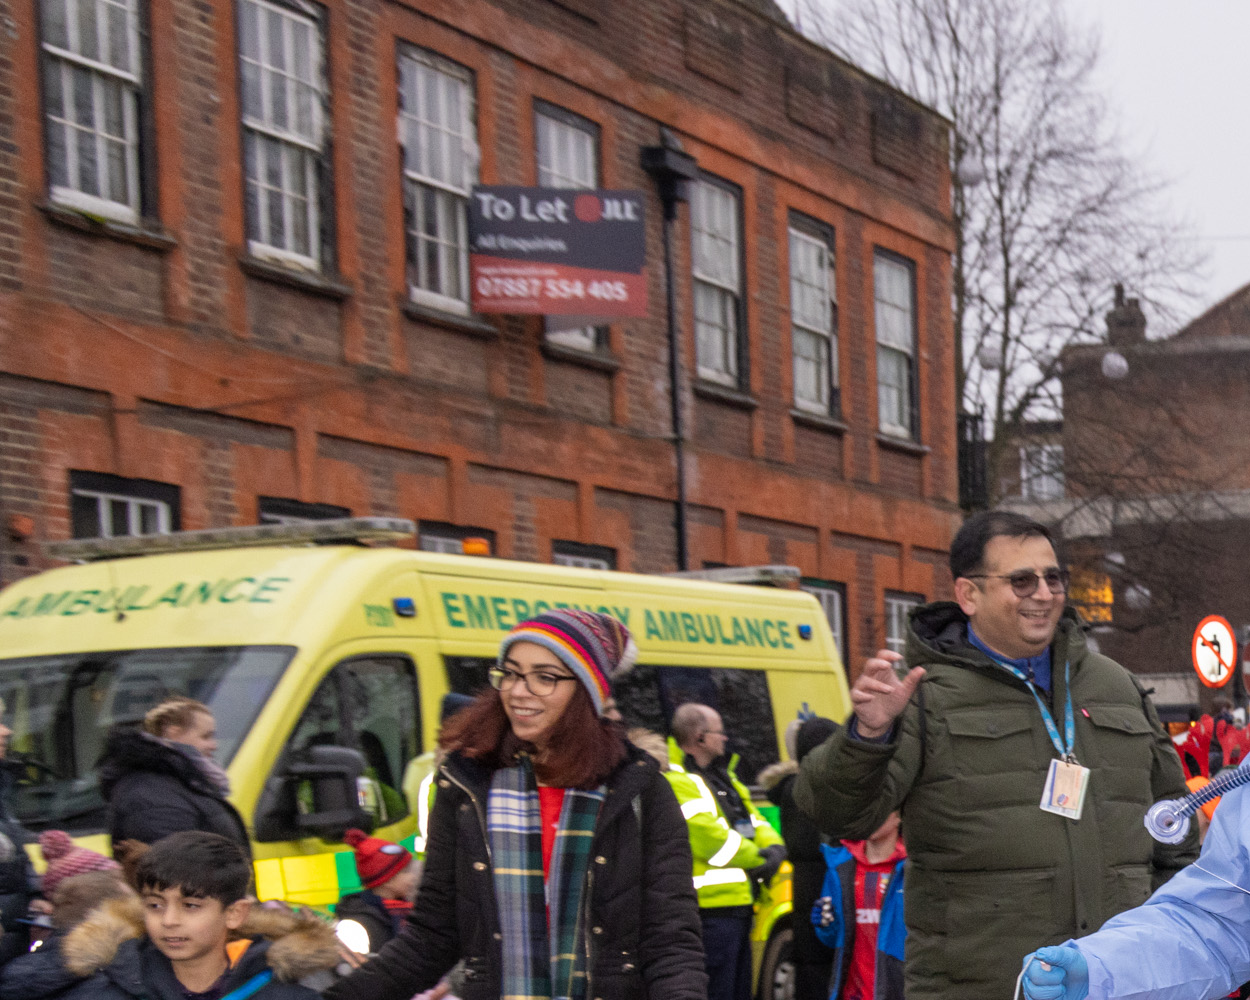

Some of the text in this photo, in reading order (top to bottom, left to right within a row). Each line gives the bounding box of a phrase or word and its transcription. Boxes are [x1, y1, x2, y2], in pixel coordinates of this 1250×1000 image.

[475, 193, 569, 223] To Let
[3, 576, 292, 618] AMBULANCE
[644, 609, 794, 649] AMBULANCE
